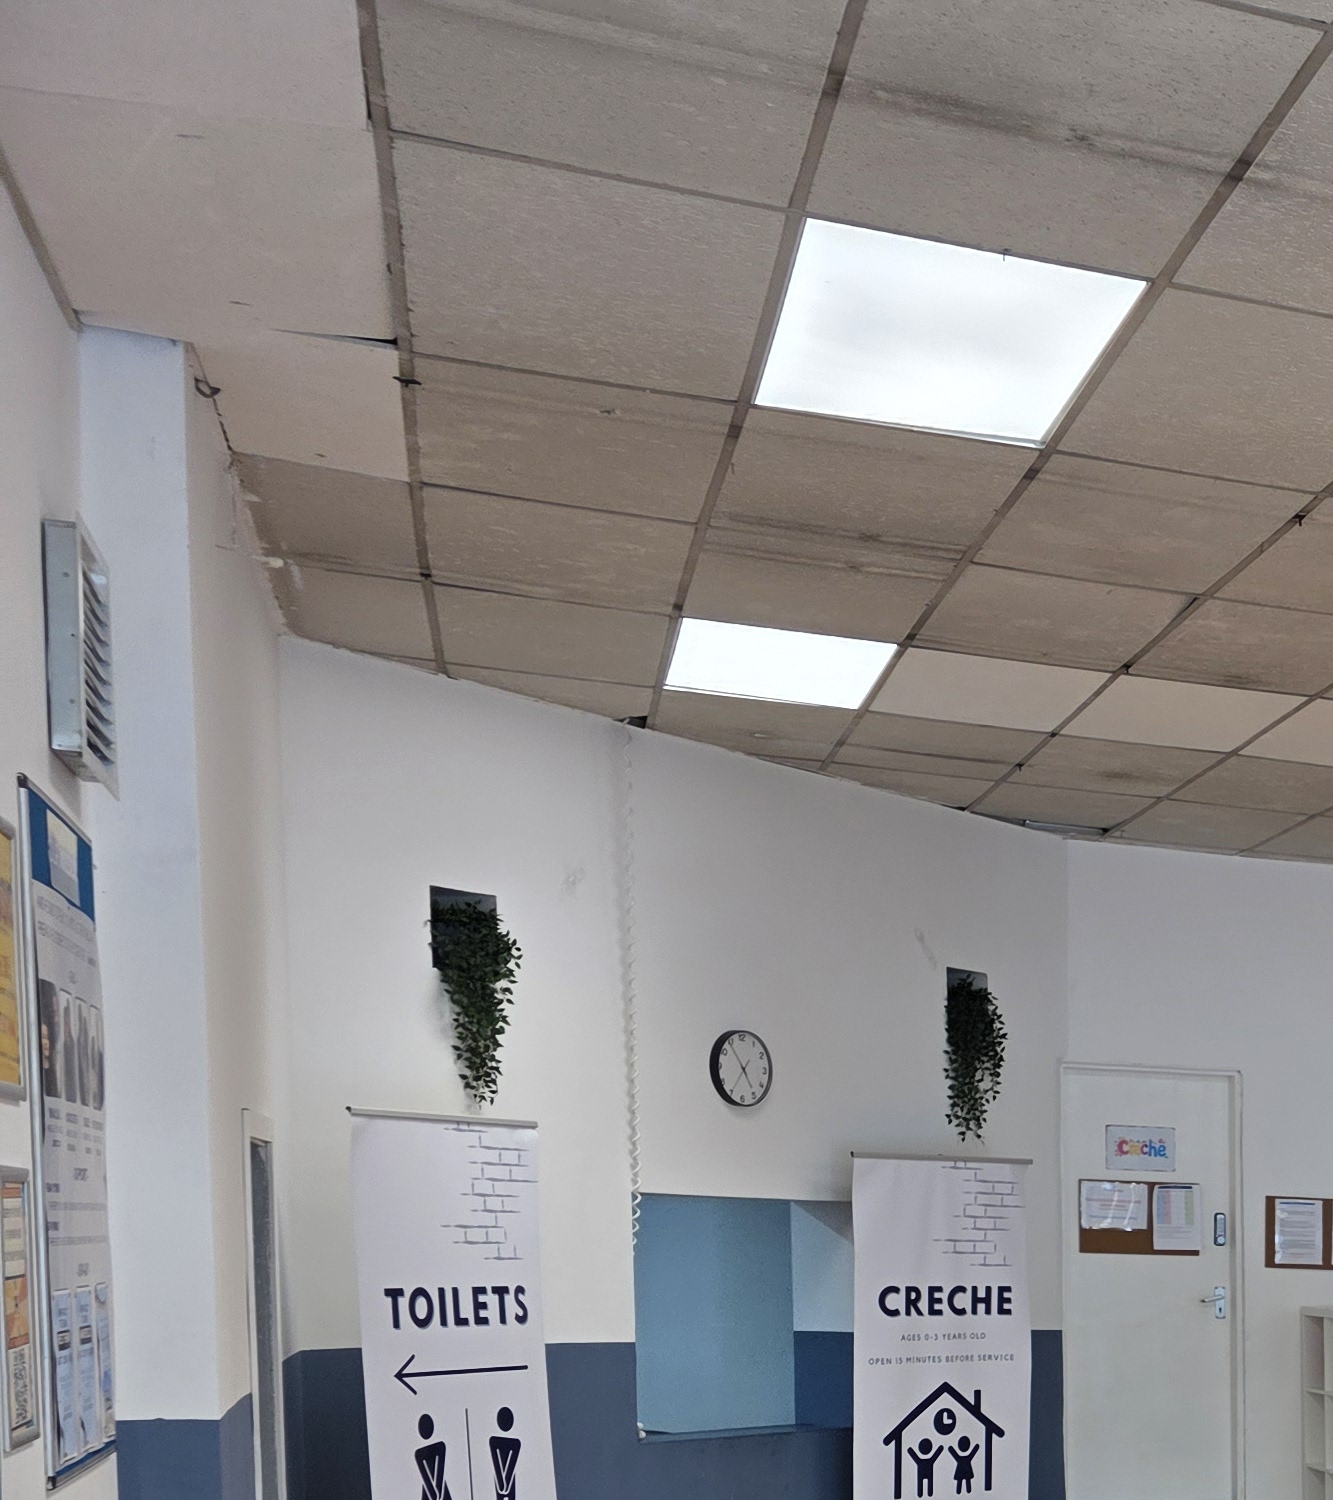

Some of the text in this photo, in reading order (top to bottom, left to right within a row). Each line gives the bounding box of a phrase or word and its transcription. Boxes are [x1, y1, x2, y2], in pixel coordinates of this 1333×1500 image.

[759, 1052, 764, 1060] 2
[762, 1067, 767, 1075] 3
[1117, 1139, 1166, 1157] Creche
[878, 1286, 1012, 1317] CRECHE
[384, 1285, 528, 1330] TOILETS
[901, 1334, 921, 1342] AGES
[924, 1333, 938, 1341] 0-3
[942, 1332, 967, 1340] YEARS
[868, 1357, 892, 1365] OPEN
[906, 1355, 942, 1364] MINUTES
[945, 1355, 974, 1363] BEFORE
[978, 1354, 1014, 1362] SERVICE
